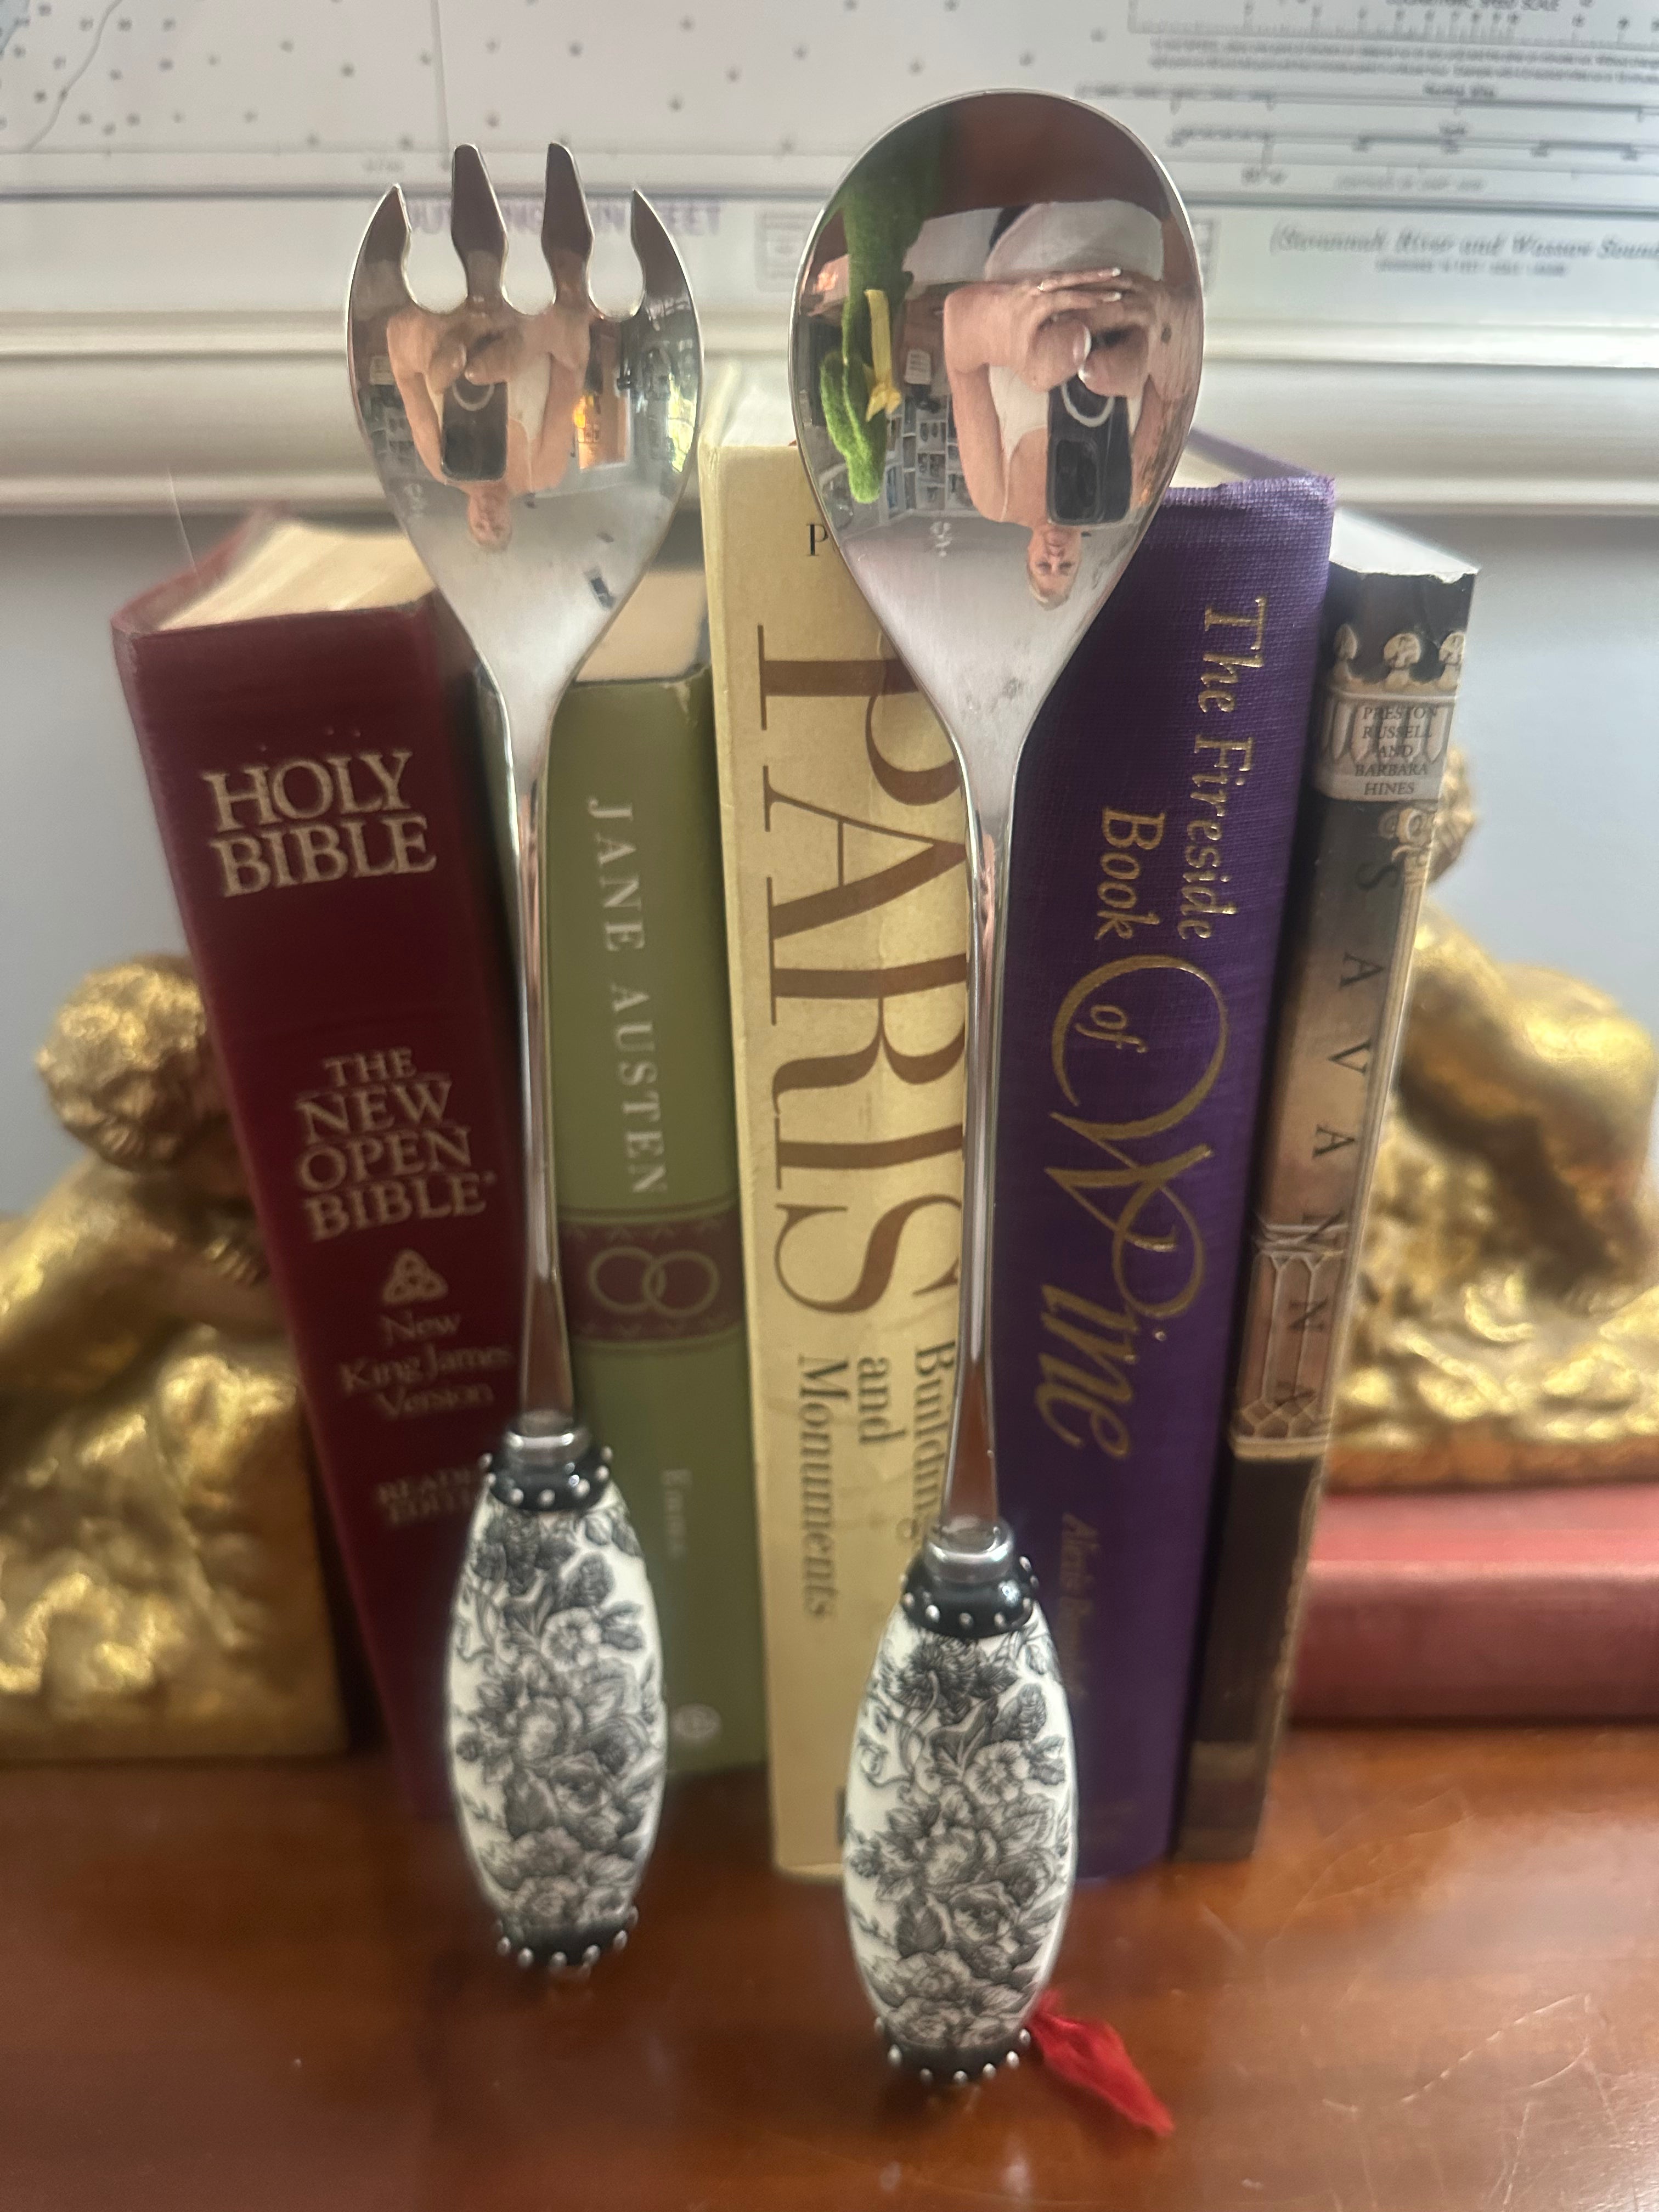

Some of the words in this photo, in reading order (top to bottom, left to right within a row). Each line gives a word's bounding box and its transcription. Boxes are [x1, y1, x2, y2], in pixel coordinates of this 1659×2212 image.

[1196, 596, 1265, 714] The
[202, 750, 413, 832] HOLY
[1354, 764, 1427, 777] BARBARA
[1363, 782, 1415, 795] HINES
[1377, 744, 1414, 758] AND
[208, 814, 438, 898] BIBLE
[587, 795, 646, 952] JANE
[1094, 805, 1167, 940] Book
[1176, 732, 1256, 940] Fireside
[758, 624, 968, 1313] PARIS
[323, 1046, 416, 1088] THE
[1074, 1004, 1149, 1053] of
[295, 1079, 453, 1146] NEW
[610, 982, 668, 1194] AUSTEN
[298, 1124, 472, 1193] OPEN
[1034, 955, 1230, 1459] Wine
[857, 1356, 907, 1446] and
[798, 1354, 850, 1617] Monuments
